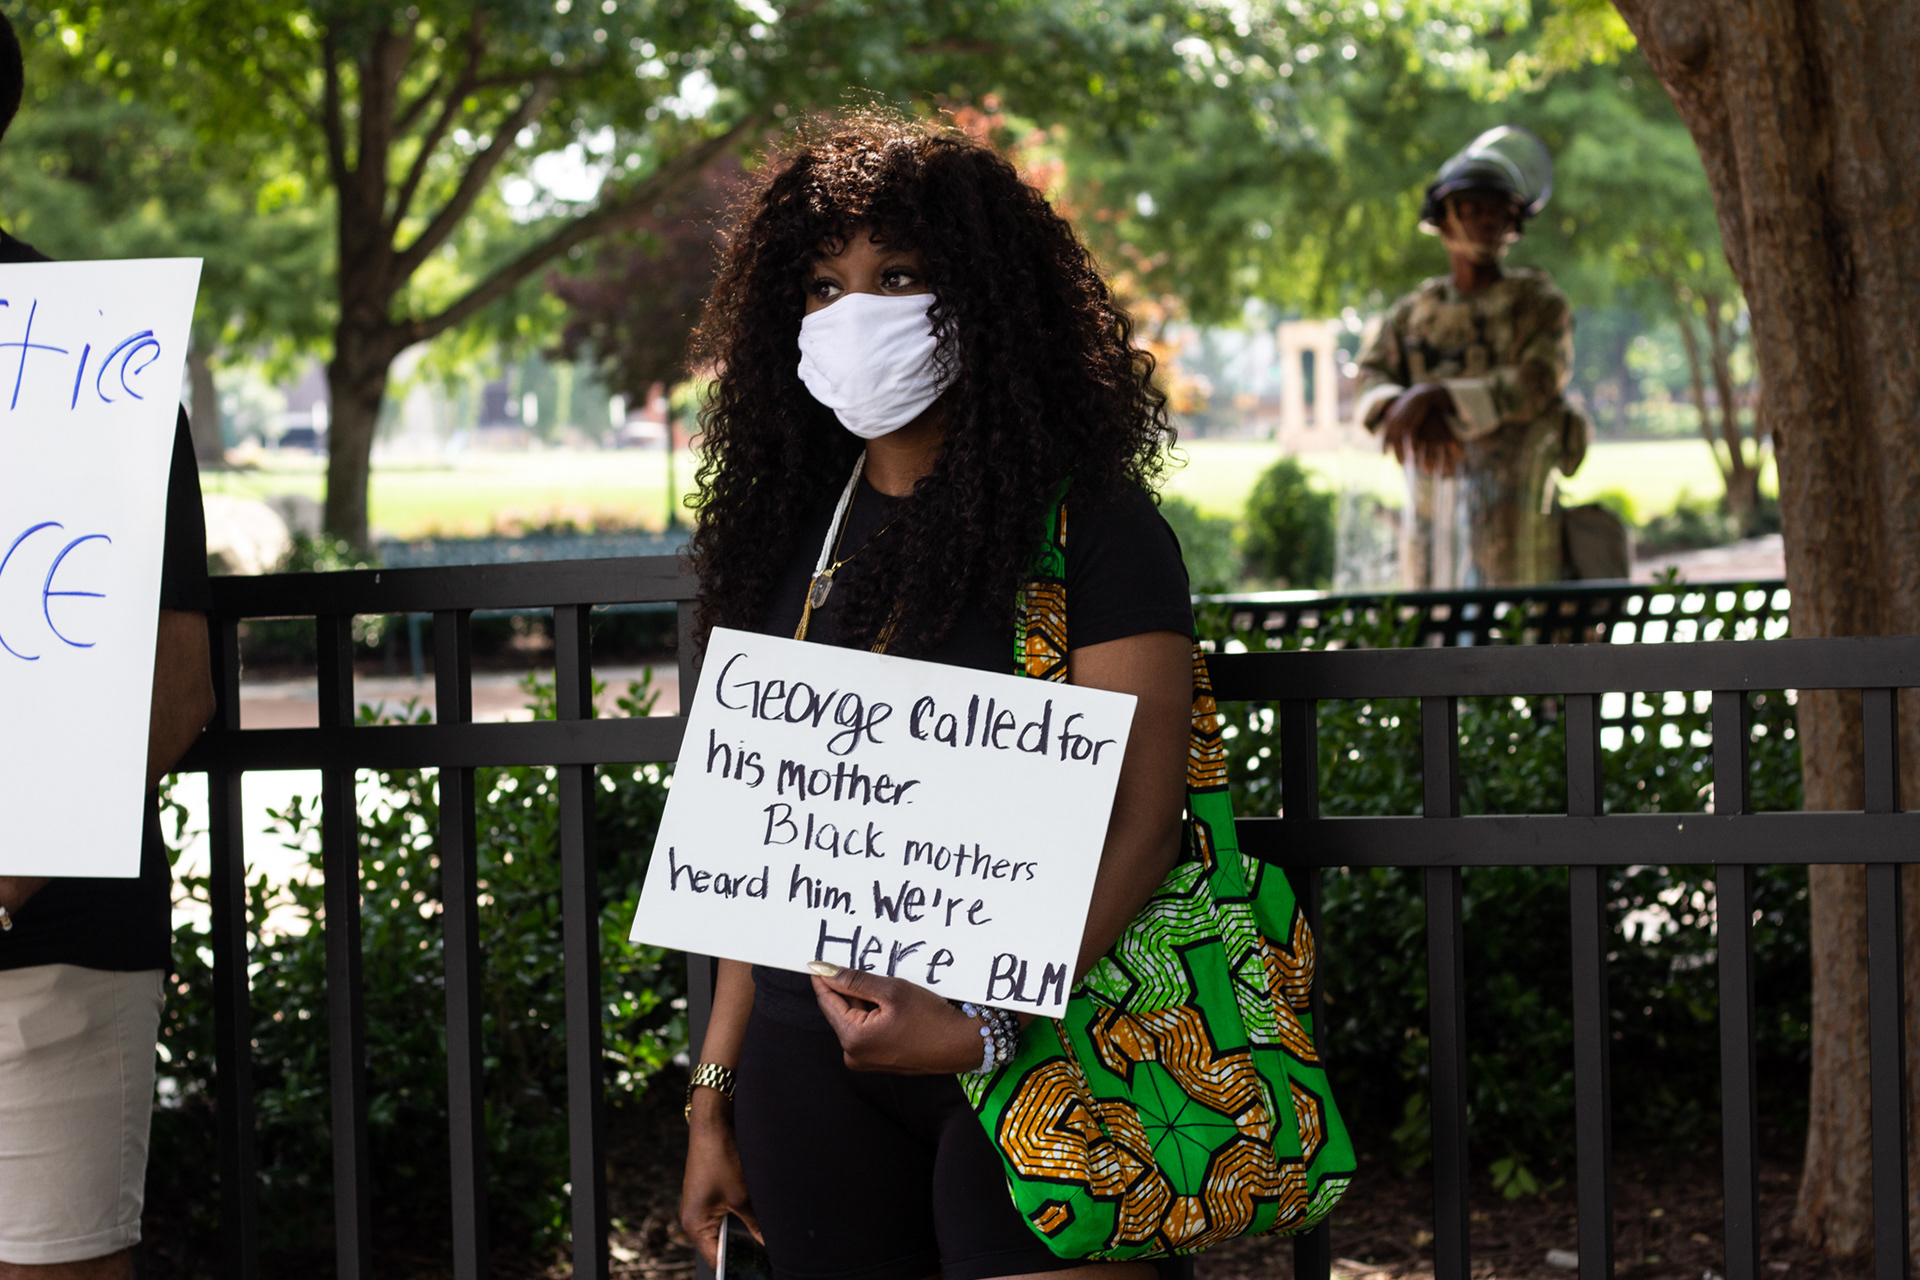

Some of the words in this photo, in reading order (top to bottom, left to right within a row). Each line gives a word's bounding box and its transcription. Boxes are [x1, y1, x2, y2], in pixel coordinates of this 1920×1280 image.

[0, 298, 161, 411] tice
[716, 652, 893, 756] George
[909, 694, 1053, 756] Called
[1057, 713, 1117, 766] for
[706, 729, 765, 789] his
[763, 803, 886, 858] Black
[903, 840, 1038, 881] mothers
[668, 847, 769, 899] heard
[788, 864, 856, 915] him.
[872, 880, 992, 927] We're
[815, 919, 955, 985] Here
[985, 953, 1068, 1006] BLM
